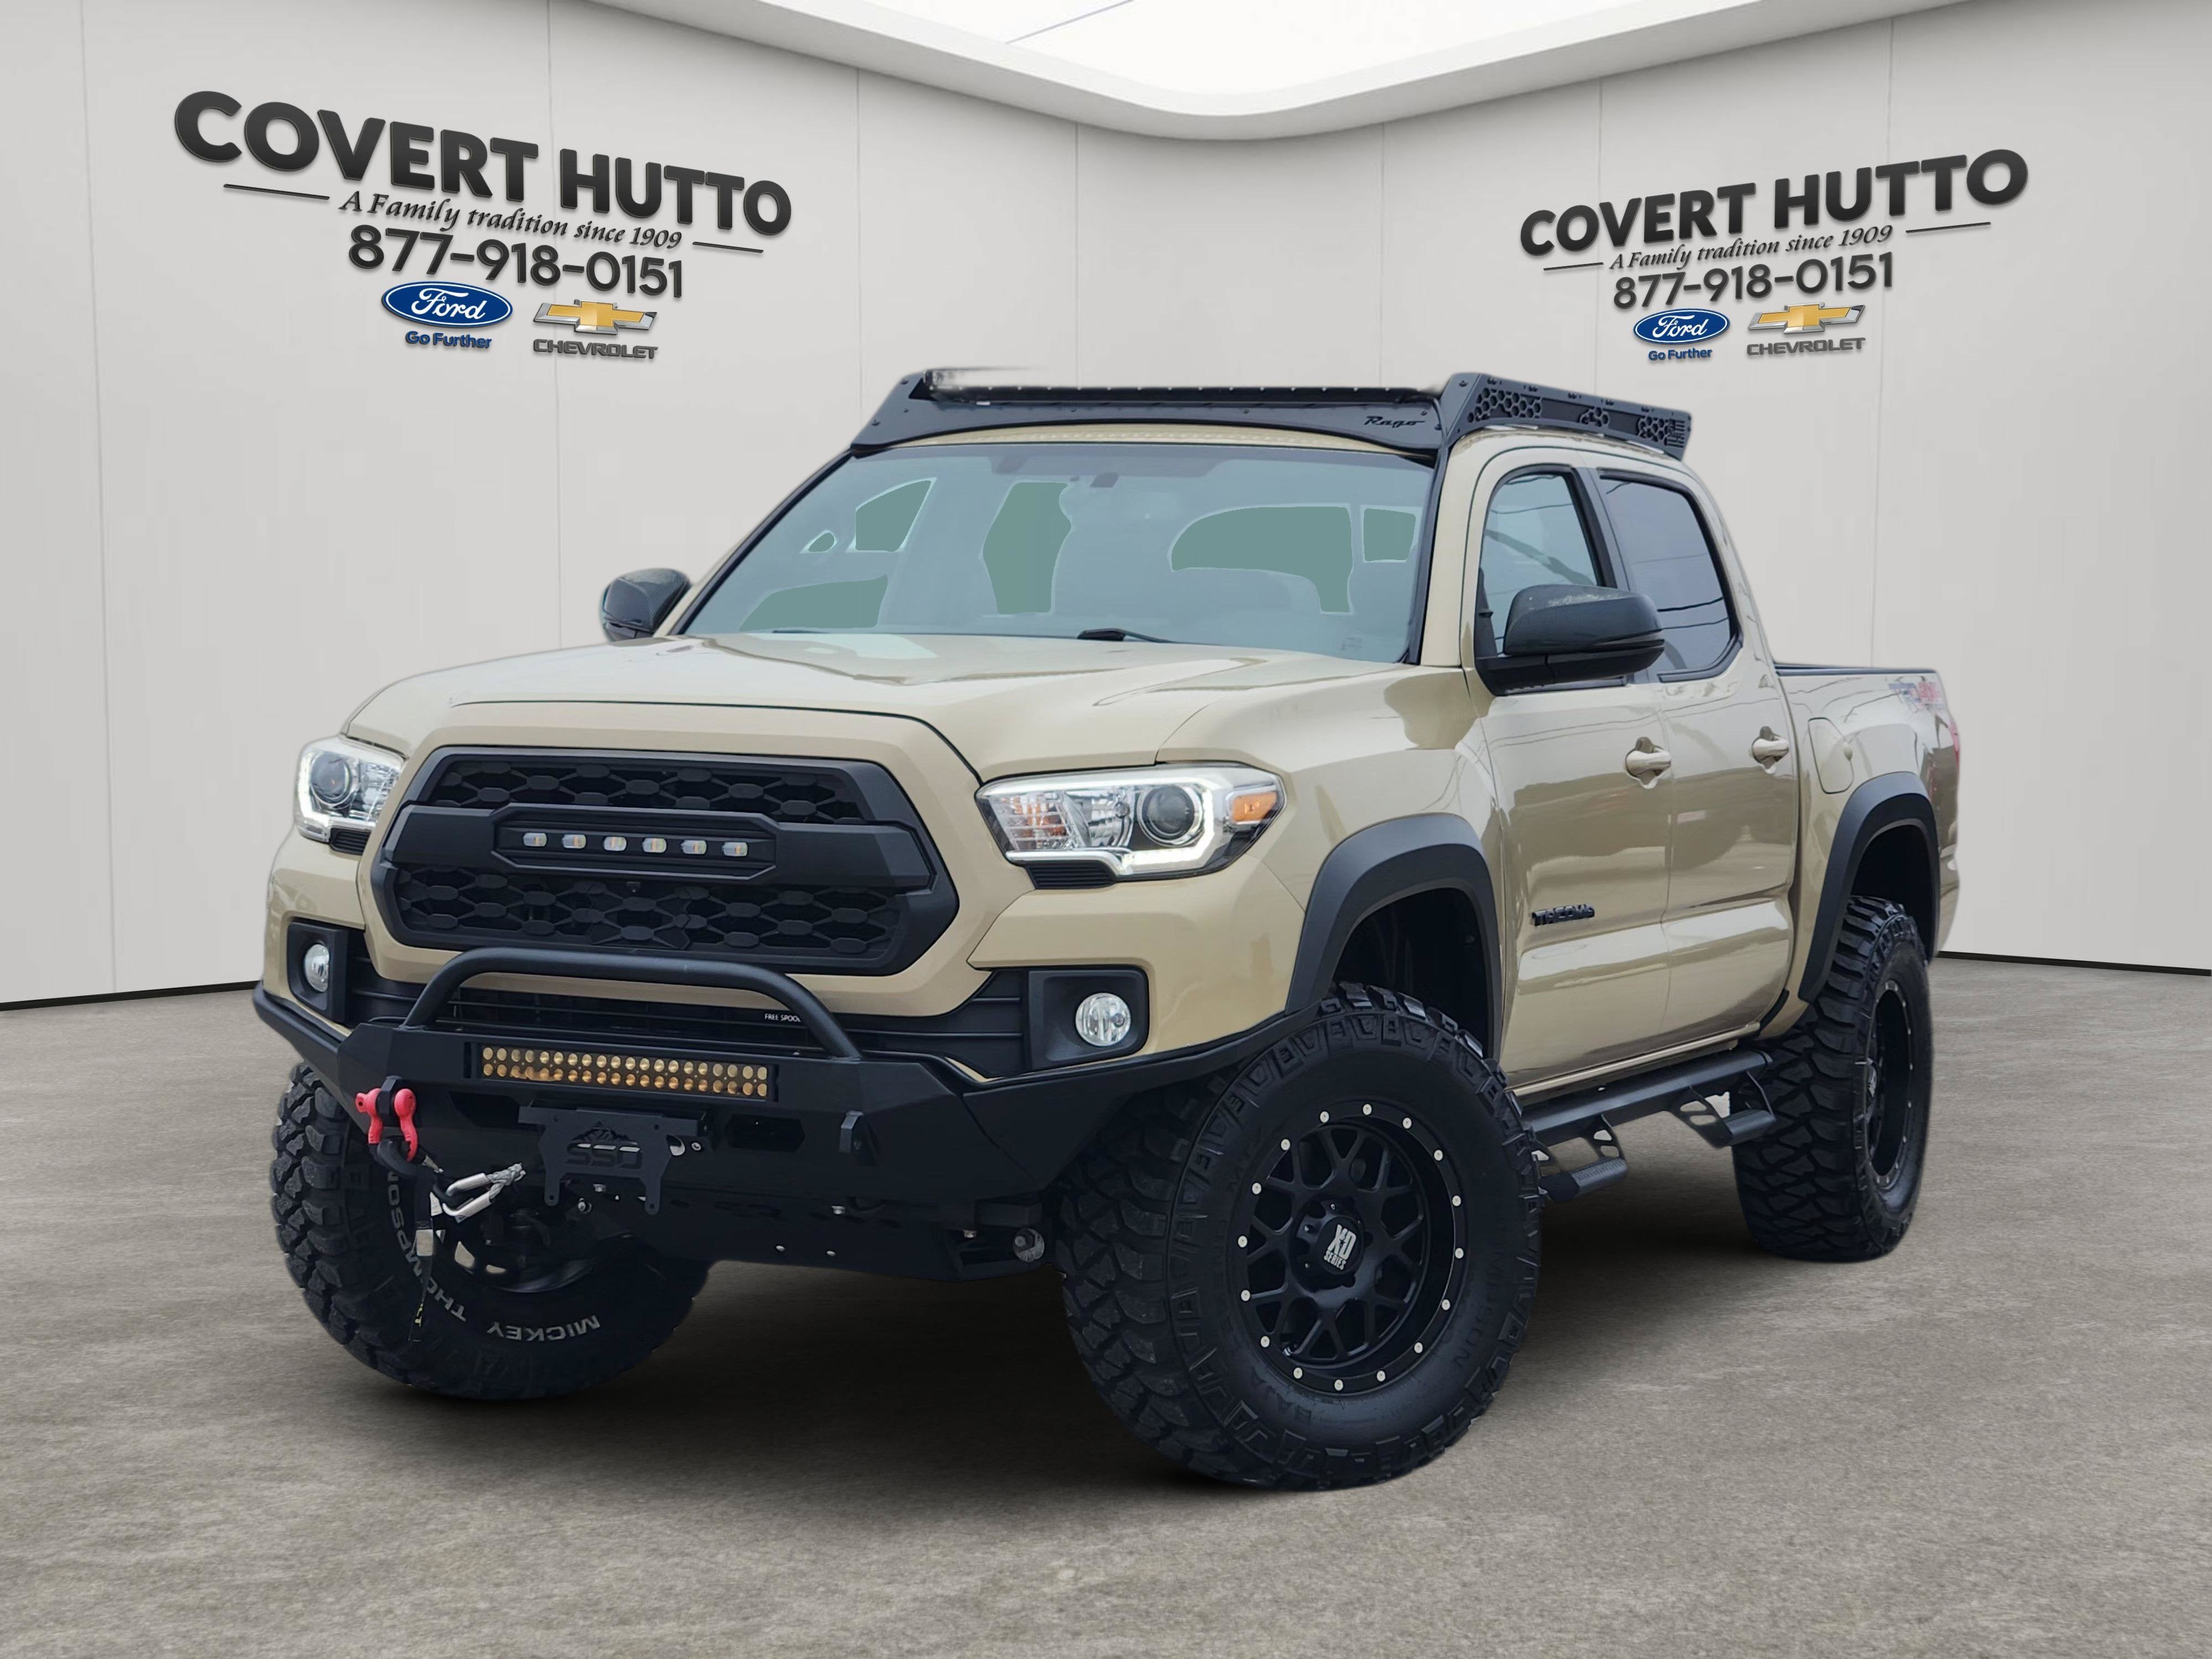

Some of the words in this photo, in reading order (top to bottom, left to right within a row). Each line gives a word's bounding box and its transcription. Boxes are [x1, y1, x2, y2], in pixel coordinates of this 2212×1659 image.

[174, 91, 539, 204] COVERT
[560, 148, 791, 237] HUTTO
[1520, 182, 1756, 257] COVERT
[1774, 149, 2028, 230] HUTTO
[338, 190, 362, 212] A
[367, 193, 461, 232] Family
[467, 207, 568, 236] tradition
[573, 221, 625, 243] since
[629, 227, 682, 249] 1909
[348, 225, 682, 299] 877-918-0151
[1609, 253, 1624, 270] A
[1626, 243, 1692, 270] Family
[1697, 237, 1780, 261] tradition
[1785, 235, 1834, 252] since
[1838, 225, 1893, 247] 1909
[1614, 251, 1892, 310] 877-918-0151
[411, 287, 487, 321] Ford
[405, 331, 431, 346] Go
[432, 332, 492, 349] Further
[1652, 315, 1709, 337] Ford
[533, 338, 659, 359] CHEVROLET
[1648, 350, 1666, 361] Go
[1667, 348, 1713, 360] Further
[1746, 337, 1866, 356] CHEVROLET
[1364, 415, 1426, 428] Rago
[1327, 1224, 1357, 1260] XD
[1323, 1250, 1347, 1270] SERIES
[486, 1315, 601, 1342] MICKEY
